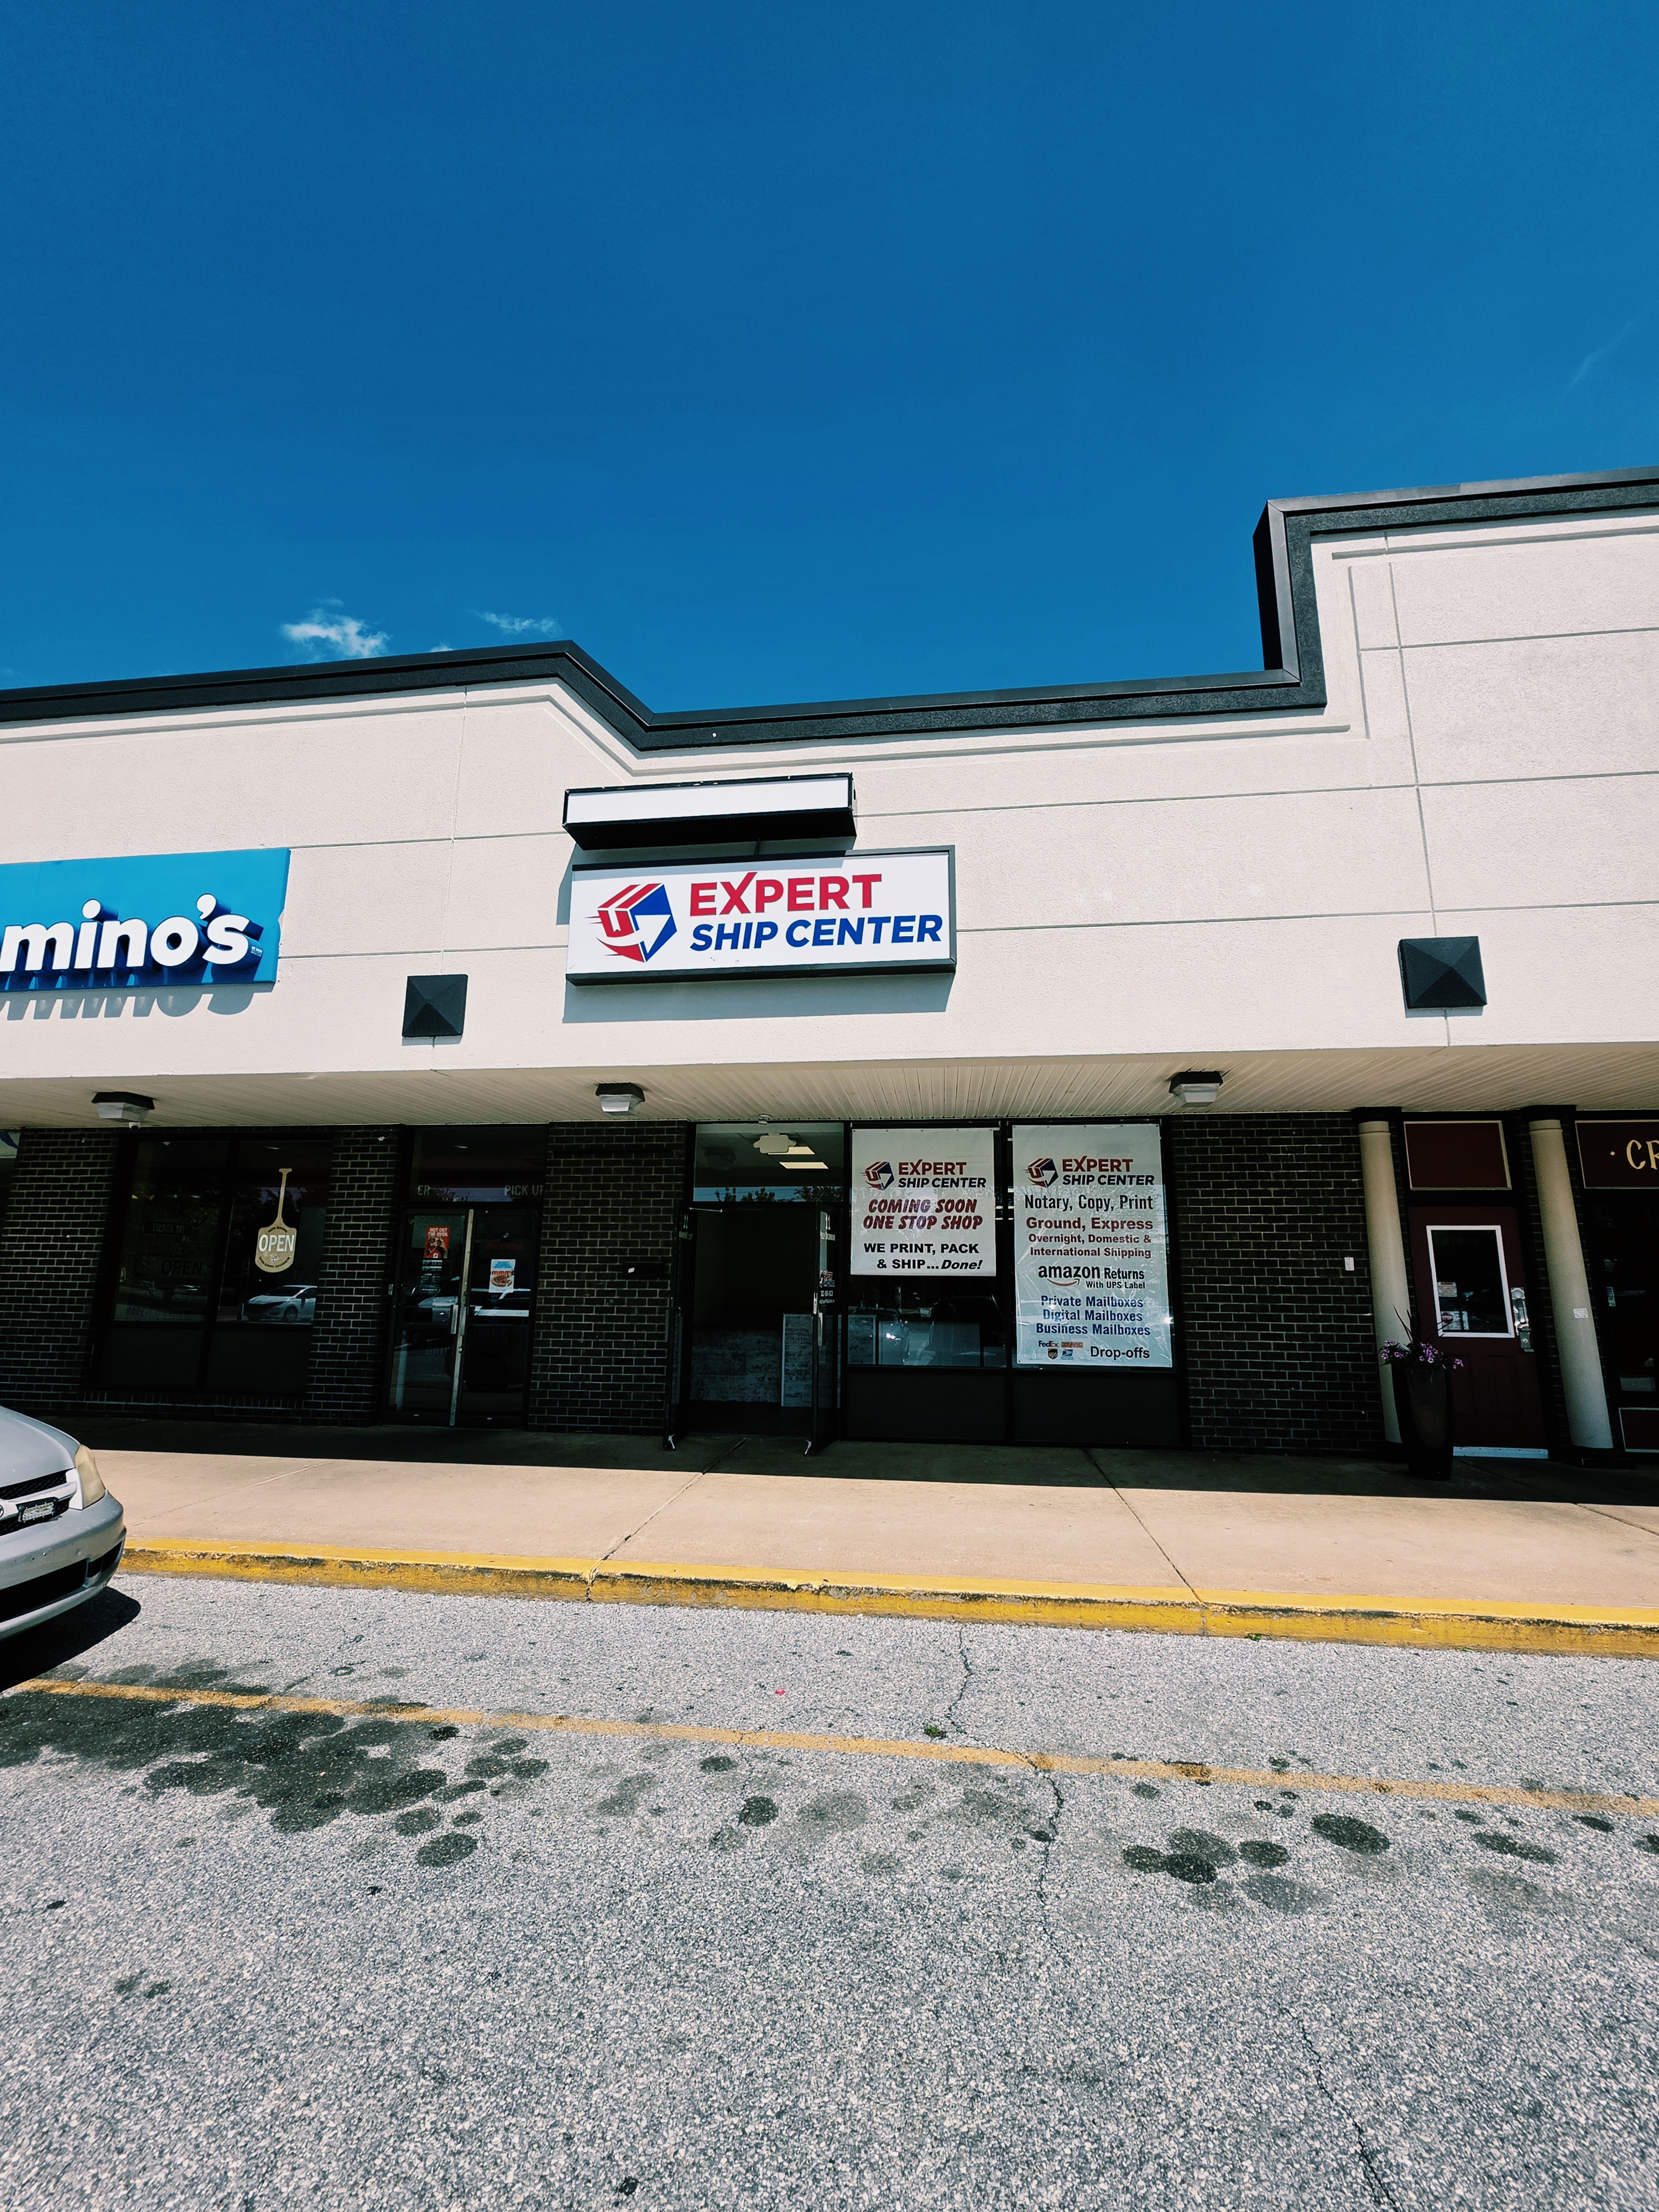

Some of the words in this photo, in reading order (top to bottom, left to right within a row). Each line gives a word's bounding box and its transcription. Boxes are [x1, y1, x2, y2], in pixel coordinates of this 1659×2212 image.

[690, 872, 882, 916] EXPERT
[690, 921, 778, 951] SHIP
[786, 914, 943, 947] CENTER
[898, 1159, 967, 1175] EXPERT
[1062, 1156, 1133, 1172] EXPERT
[898, 1177, 929, 1188] SHIP
[932, 1177, 987, 1188] CENTER
[1062, 1175, 1095, 1185] SHIP
[1098, 1175, 1155, 1186] CENTER
[504, 1185, 529, 1196] PICK
[869, 1199, 931, 1213] COMING
[935, 1199, 977, 1213] SOON
[1025, 1194, 1073, 1212] Notary,
[1078, 1194, 1114, 1212] Copy,
[1120, 1194, 1153, 1209] Print
[863, 1215, 894, 1229] ONE
[898, 1215, 937, 1229] STOP
[941, 1215, 983, 1229] SHOP
[1026, 1217, 1086, 1232] Ground,
[1091, 1217, 1153, 1232] Express
[259, 1234, 295, 1252] OPEN
[1029, 1234, 1084, 1244] Overnight,
[1088, 1234, 1139, 1243] Domestic
[1144, 1234, 1151, 1243] &
[863, 1243, 885, 1253] WE
[890, 1243, 936, 1255] PRINT,
[941, 1244, 979, 1254] PACK
[1030, 1247, 1100, 1256] International
[1104, 1248, 1151, 1259] Shipping
[161, 1260, 203, 1275] OPEN
[877, 1259, 887, 1269] &
[1038, 1265, 1100, 1279] amazon
[1104, 1267, 1145, 1280] Returns
[1041, 1295, 1081, 1307] Private
[1086, 1296, 1144, 1307] Mailboxes
[1043, 1309, 1079, 1321] Digital
[1085, 1310, 1142, 1321] Mailboxes
[1036, 1323, 1088, 1334] Business
[1092, 1324, 1151, 1335] Mailboxes
[1091, 1346, 1150, 1360] Drop-offs
